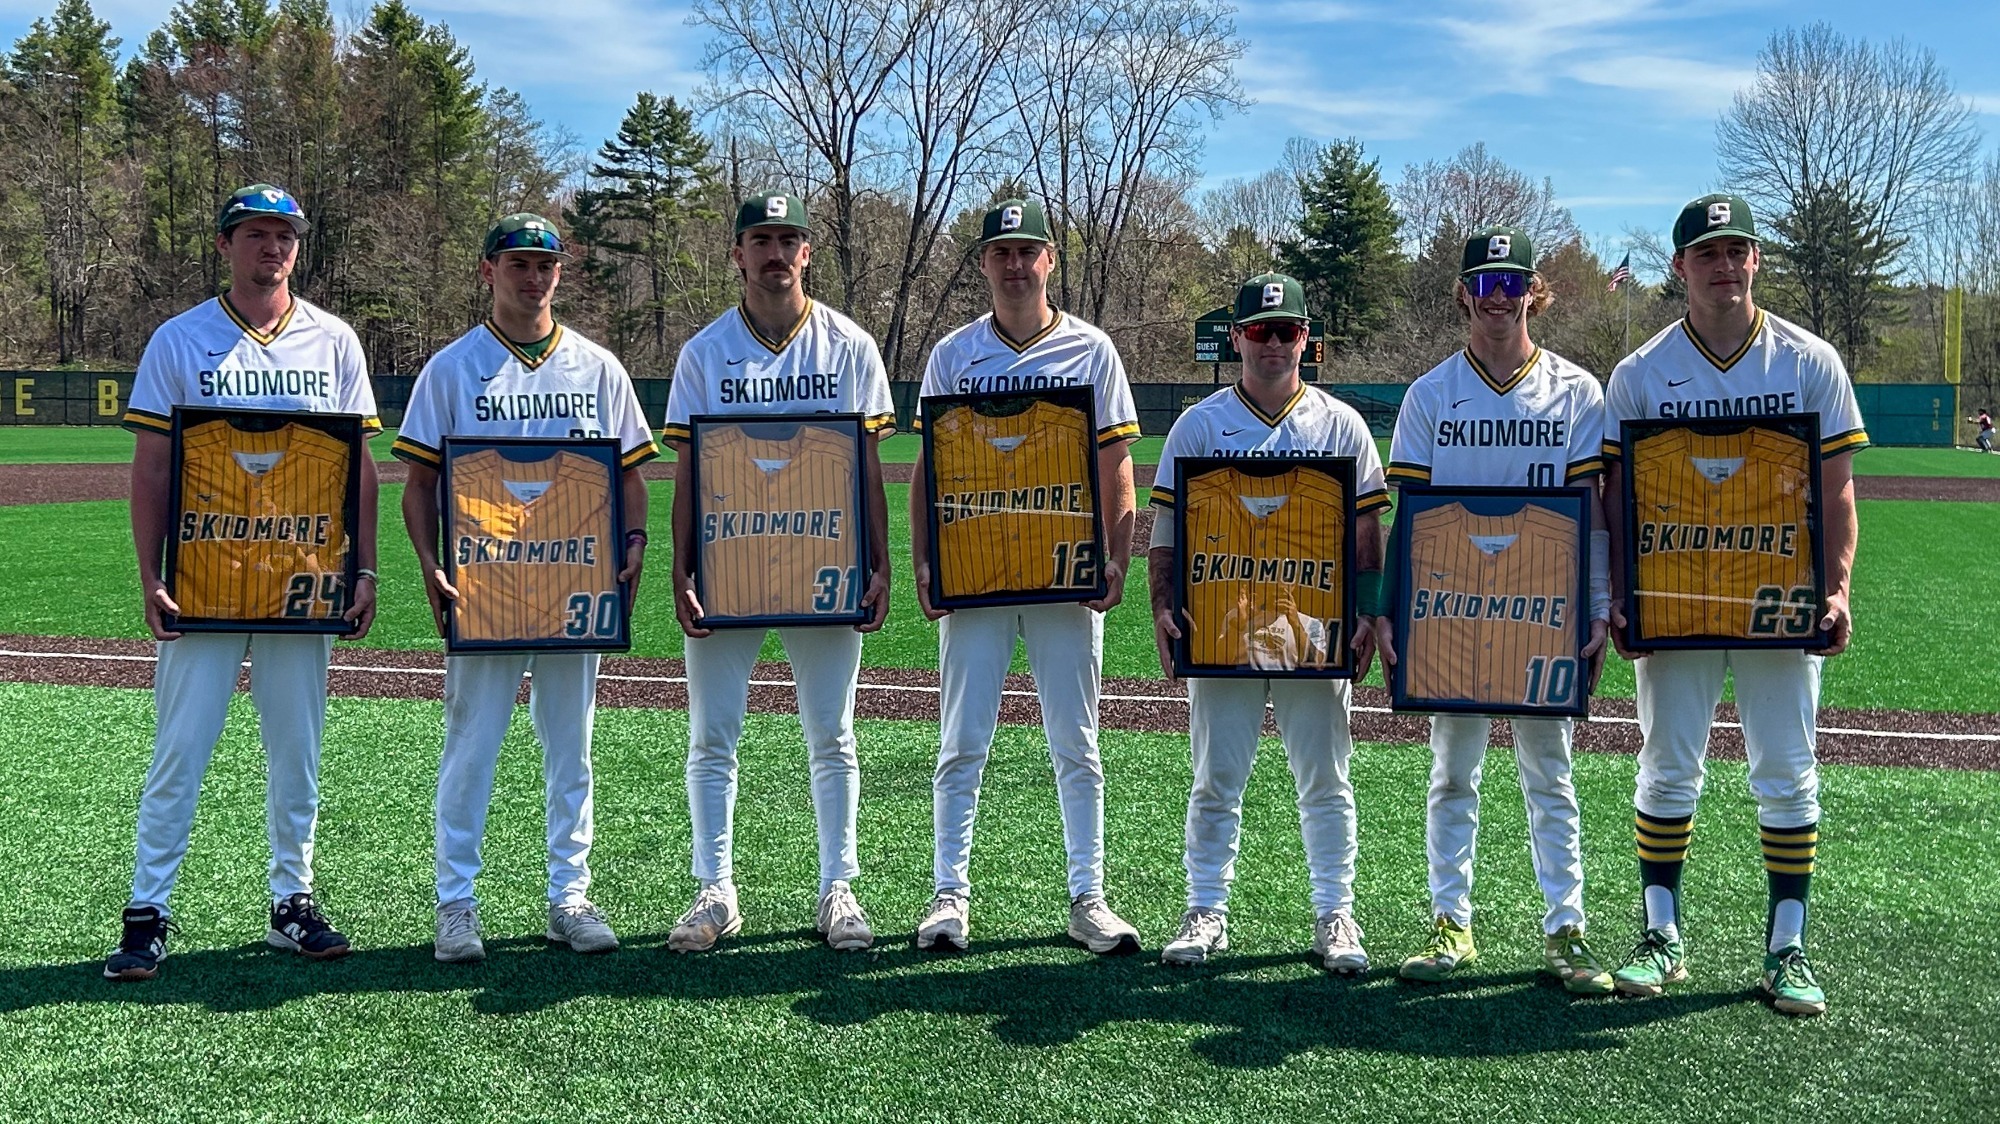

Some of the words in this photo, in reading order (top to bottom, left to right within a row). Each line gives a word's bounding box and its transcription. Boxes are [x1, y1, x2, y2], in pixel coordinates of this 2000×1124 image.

[766, 196, 788, 219] S
[1001, 206, 1022, 231] S
[1707, 202, 1731, 228] S
[1487, 234, 1511, 261] S
[1261, 282, 1284, 308] S
[1196, 342, 1219, 351] GUEST
[1316, 342, 1322, 352] 0
[1316, 352, 1322, 362] 0
[199, 369, 330, 399] SKIDMORE
[719, 372, 839, 404] SKIDMORE
[1182, 395, 1205, 404] Jack
[475, 391, 597, 423] SKIDMORE
[1659, 391, 1796, 419] SKIDMORE
[1932, 398, 1940, 431] 315
[1437, 418, 1566, 448] SKIDMORE
[1527, 461, 1554, 487] 10
[942, 481, 1083, 526] SKIDMORE
[179, 511, 332, 547] SKIDMORE
[704, 508, 844, 544] SKIDMORE
[1639, 522, 1798, 558] SKIDMORE
[455, 534, 599, 568] SKIDMORE
[1050, 539, 1099, 588] 12
[1190, 552, 1336, 593] SKIDMORE
[282, 572, 347, 619] 24
[811, 565, 861, 614] 31
[563, 590, 621, 639] 30
[1411, 588, 1568, 630] SKIDMORE
[1749, 584, 1817, 638] 23
[1524, 655, 1579, 707] 10
